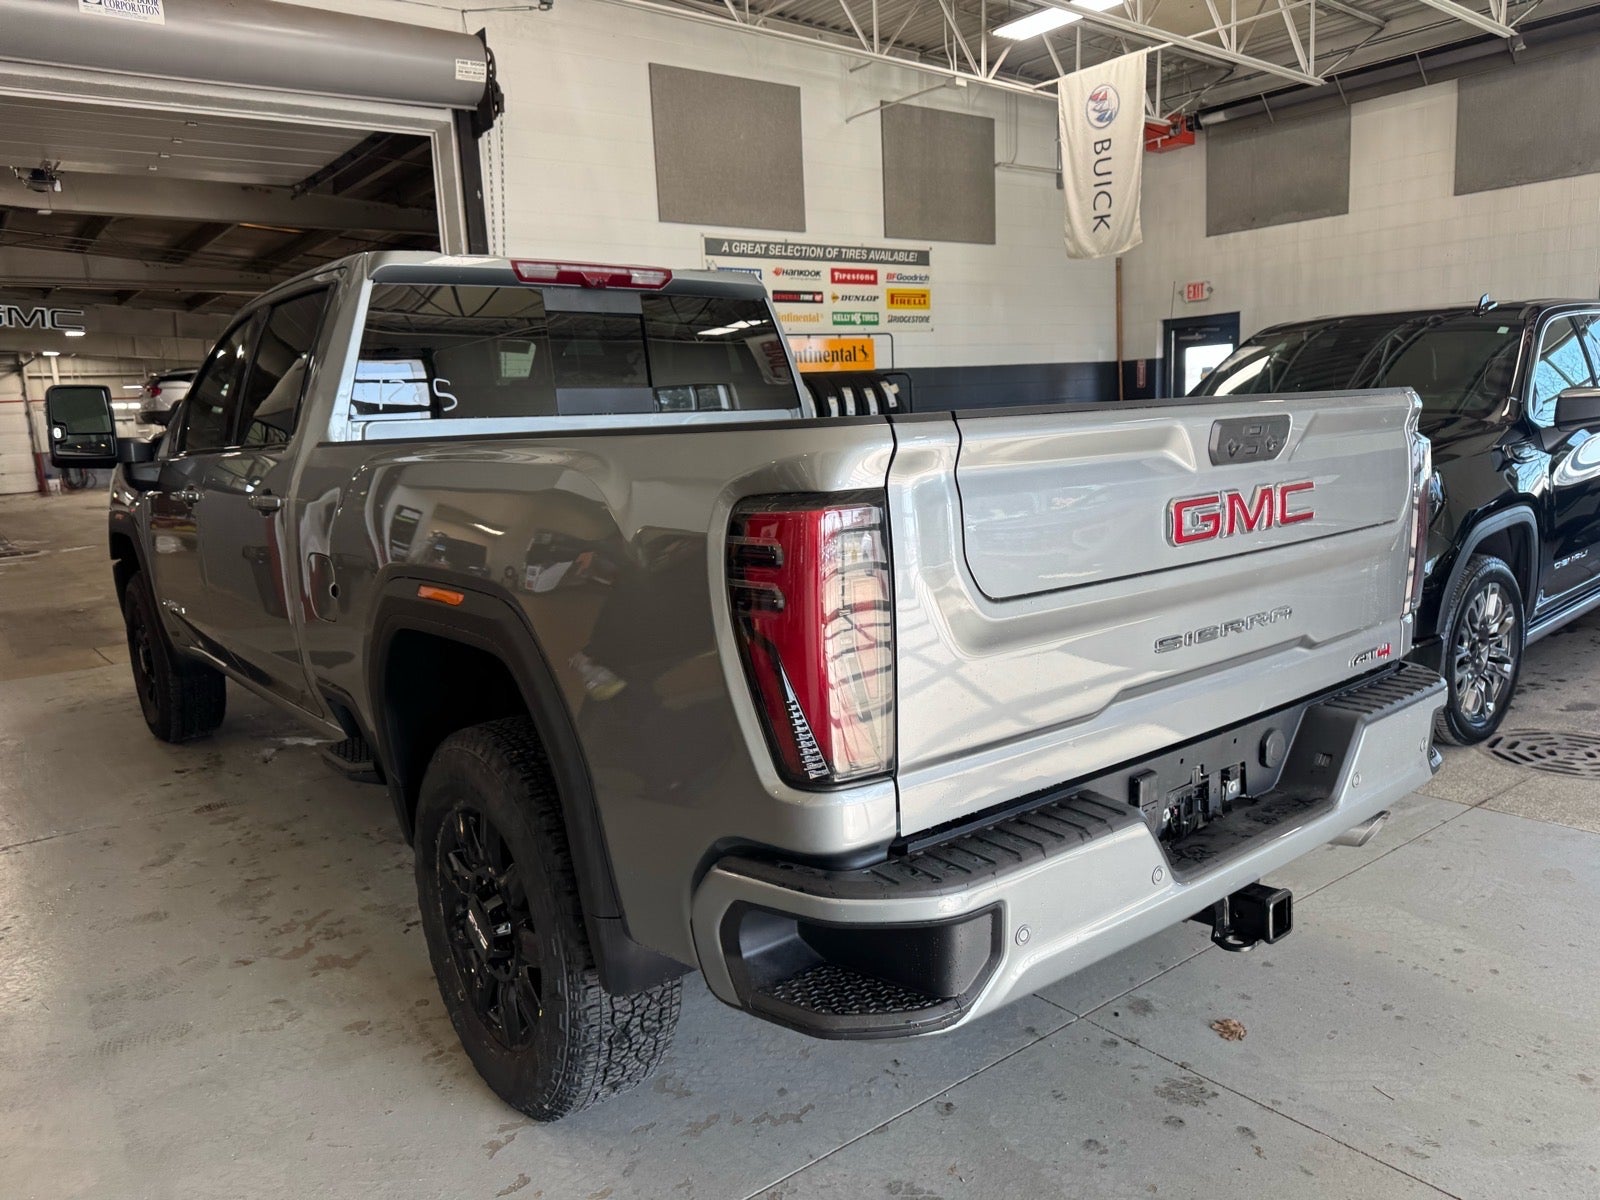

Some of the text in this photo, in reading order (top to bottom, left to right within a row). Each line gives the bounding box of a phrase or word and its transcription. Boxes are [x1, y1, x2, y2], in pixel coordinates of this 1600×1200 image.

[104, 0, 160, 15] CORPORATION
[1093, 138, 1112, 233] BUICK
[721, 241, 918, 262] A GREAT SELECTION OF TIRES AVAILABLE!
[834, 271, 875, 282] Firestone
[841, 294, 880, 302] DUNLOP
[890, 293, 927, 305] PIRELLI
[1186, 282, 1205, 300] EXIT
[0, 305, 85, 331] MC
[777, 312, 820, 323] ontinental
[887, 314, 930, 323] BRIDGESTONE
[794, 345, 857, 363] ntinental
[1166, 480, 1316, 547] GMC
[1154, 605, 1293, 654] SIERRA
[1349, 643, 1392, 668] AT4
